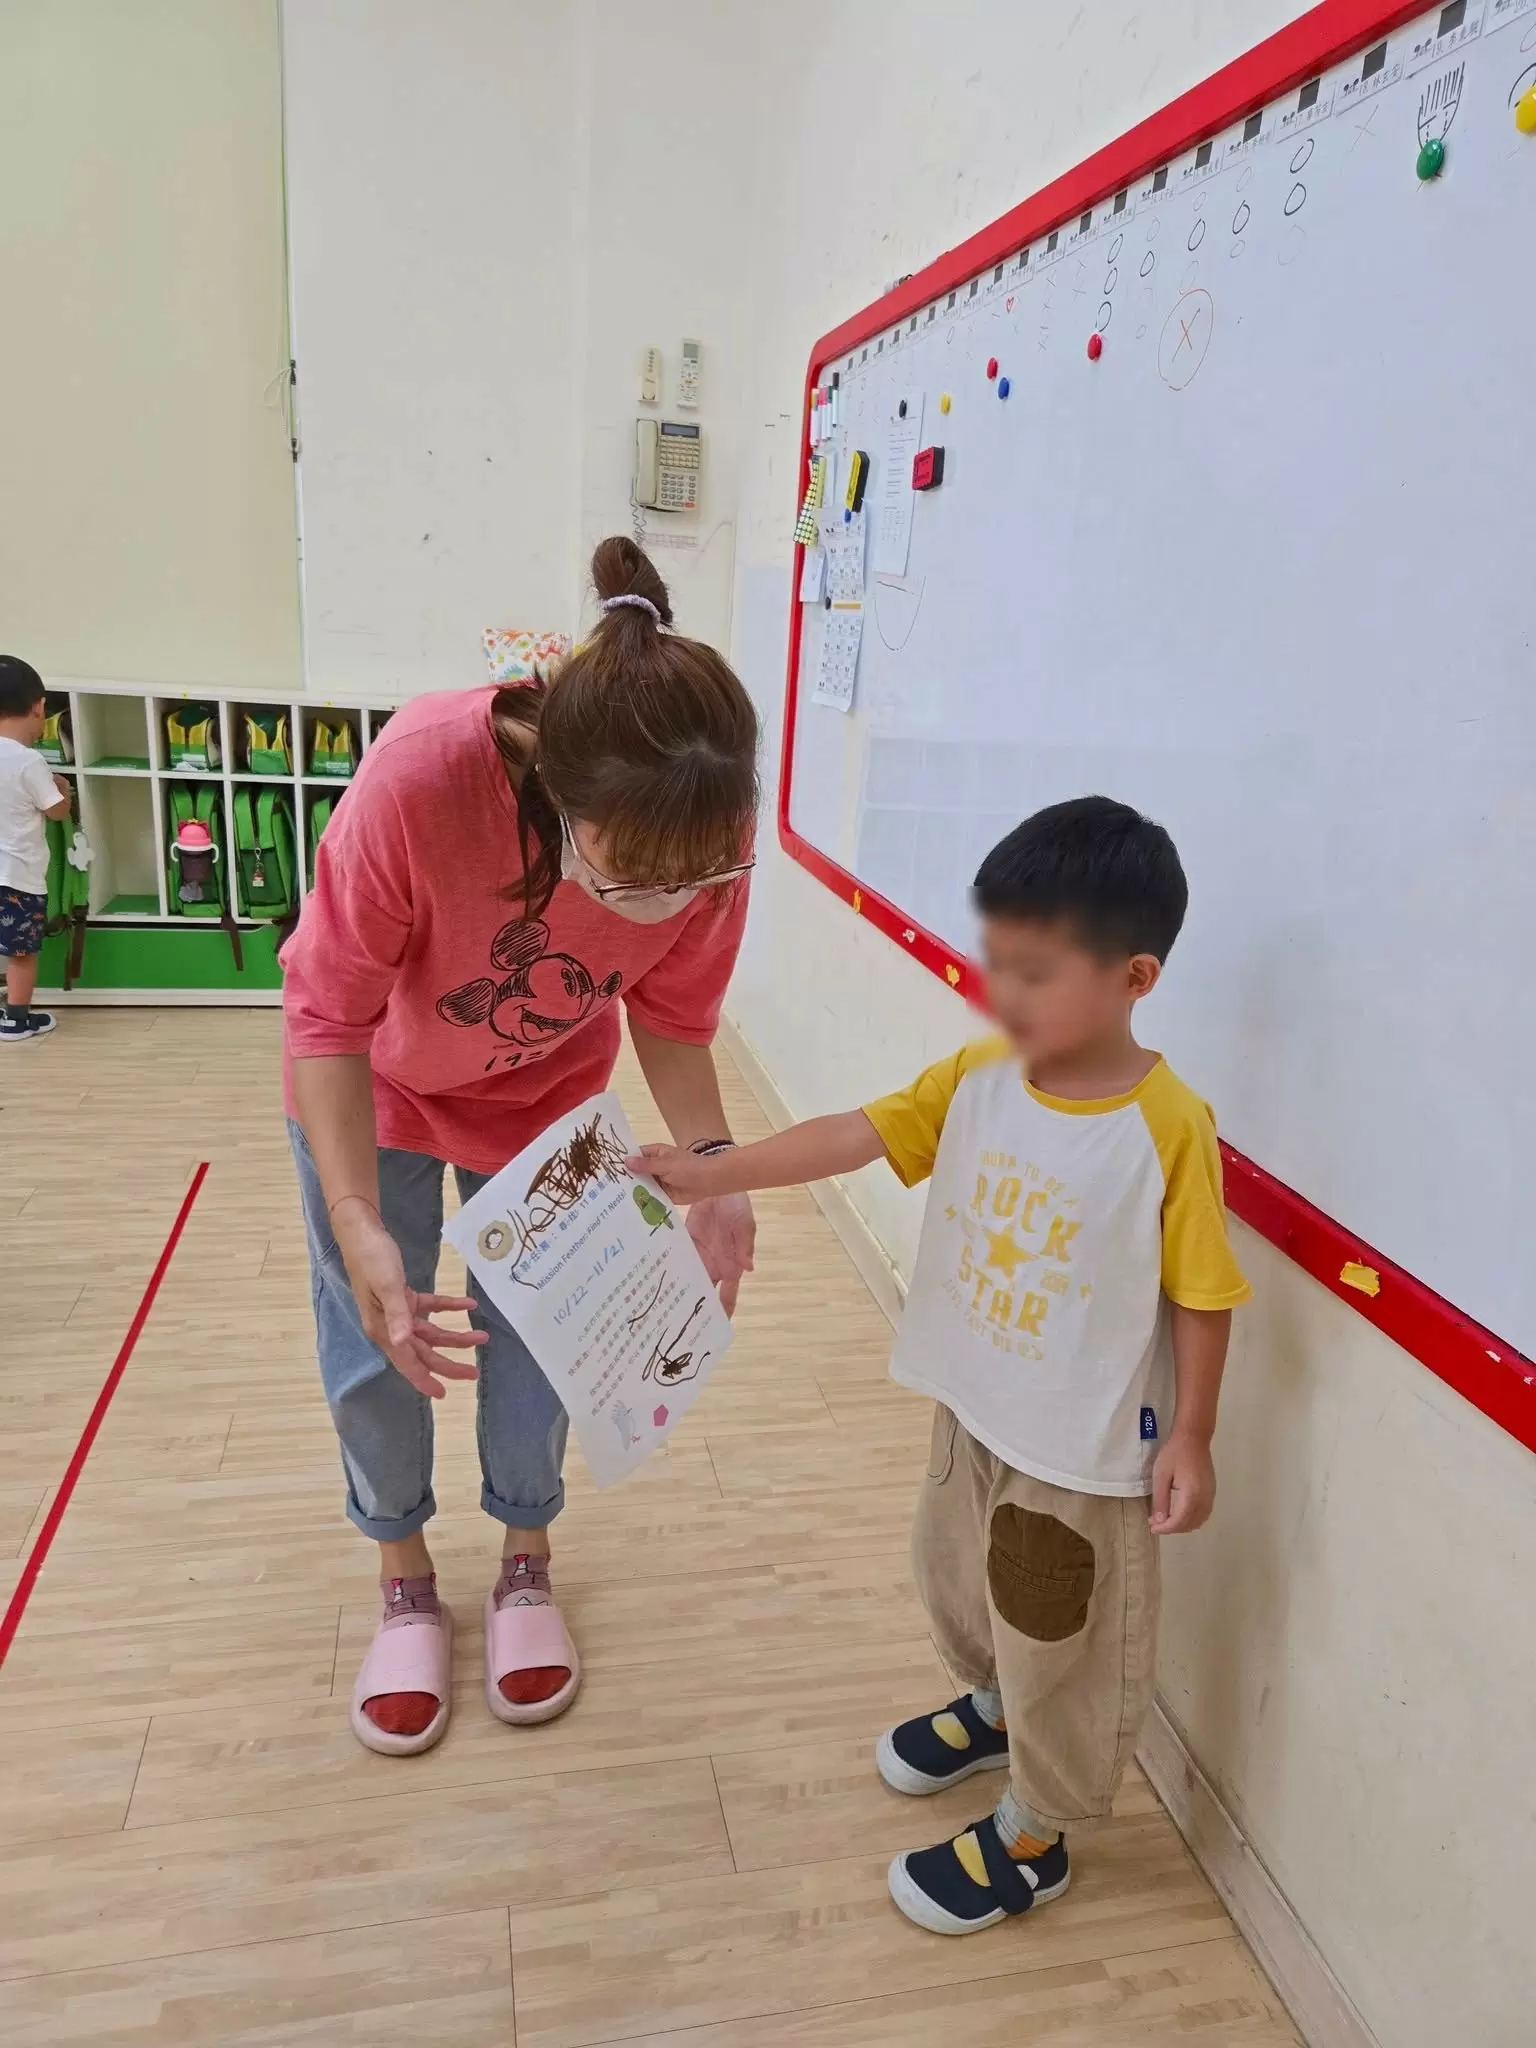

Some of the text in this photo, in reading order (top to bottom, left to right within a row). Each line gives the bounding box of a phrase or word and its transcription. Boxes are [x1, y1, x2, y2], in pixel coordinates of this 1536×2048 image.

[537, 1263, 565, 1290] Mission
[561, 1233, 589, 1263] Feather:
[587, 1217, 601, 1235] Find
[970, 1172, 1084, 1263] ROCK
[958, 1244, 1049, 1337] STAR
